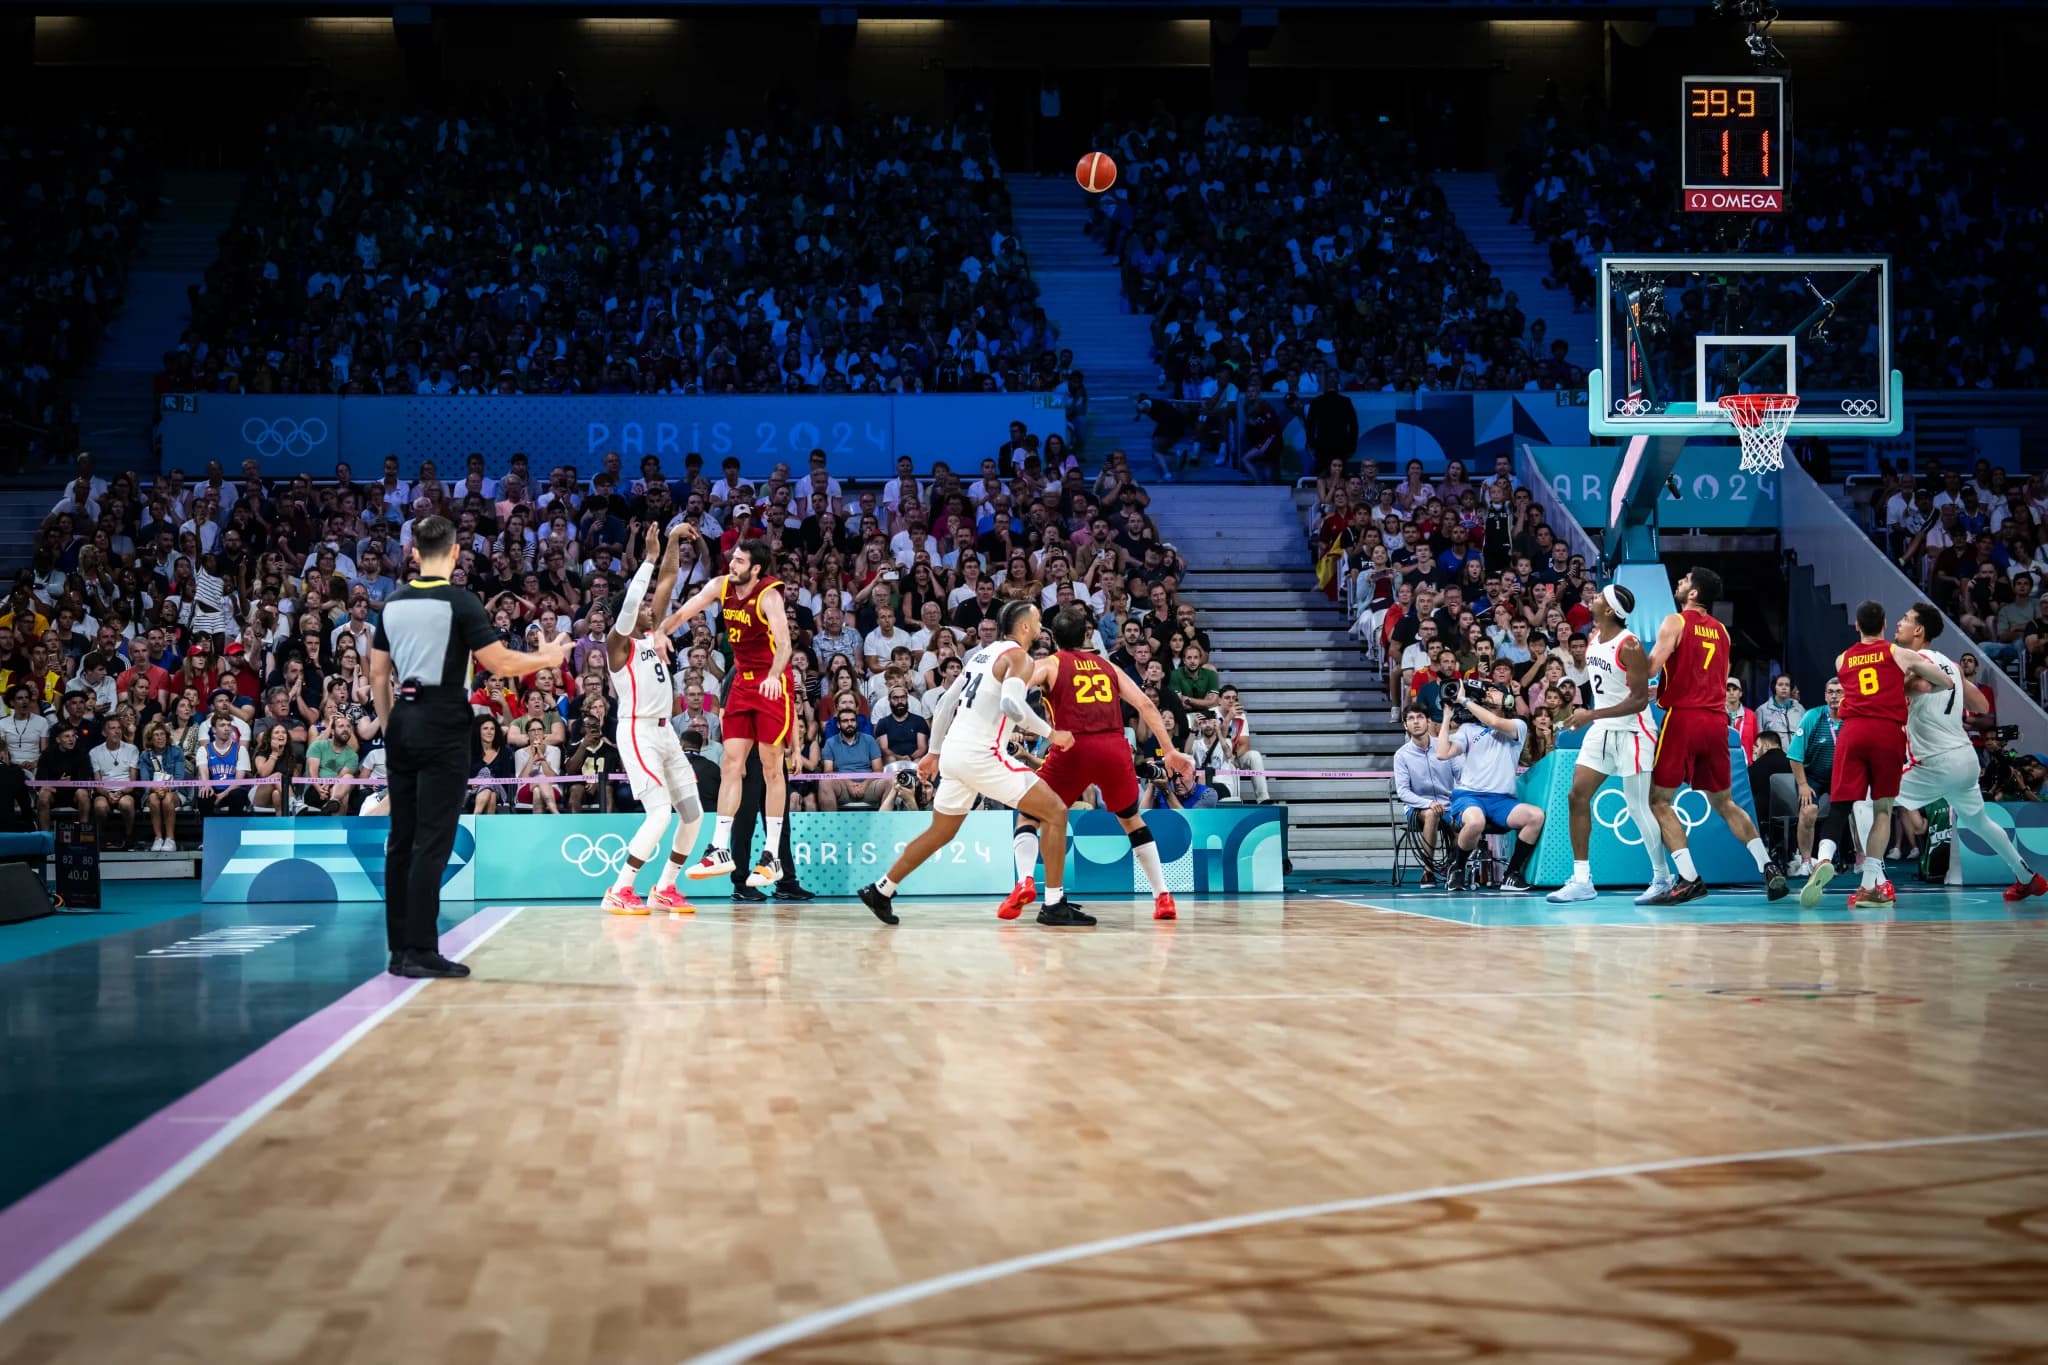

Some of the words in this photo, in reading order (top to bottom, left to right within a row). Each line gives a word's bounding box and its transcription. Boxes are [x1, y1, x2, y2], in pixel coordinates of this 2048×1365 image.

[1692, 89, 1755, 117] 39.9
[1711, 193, 1778, 208] OMEGA
[755, 421, 887, 453] 2024
[728, 627, 742, 643] 21
[1586, 656, 1613, 674] CANADA
[1702, 641, 1715, 670] 7
[1848, 651, 1885, 669] BRIZUELA
[654, 662, 666, 683] 9
[1858, 667, 1879, 696] 8
[1073, 673, 1113, 704] 23
[1594, 674, 1605, 695] 2
[67, 870, 89, 881] 40.0
